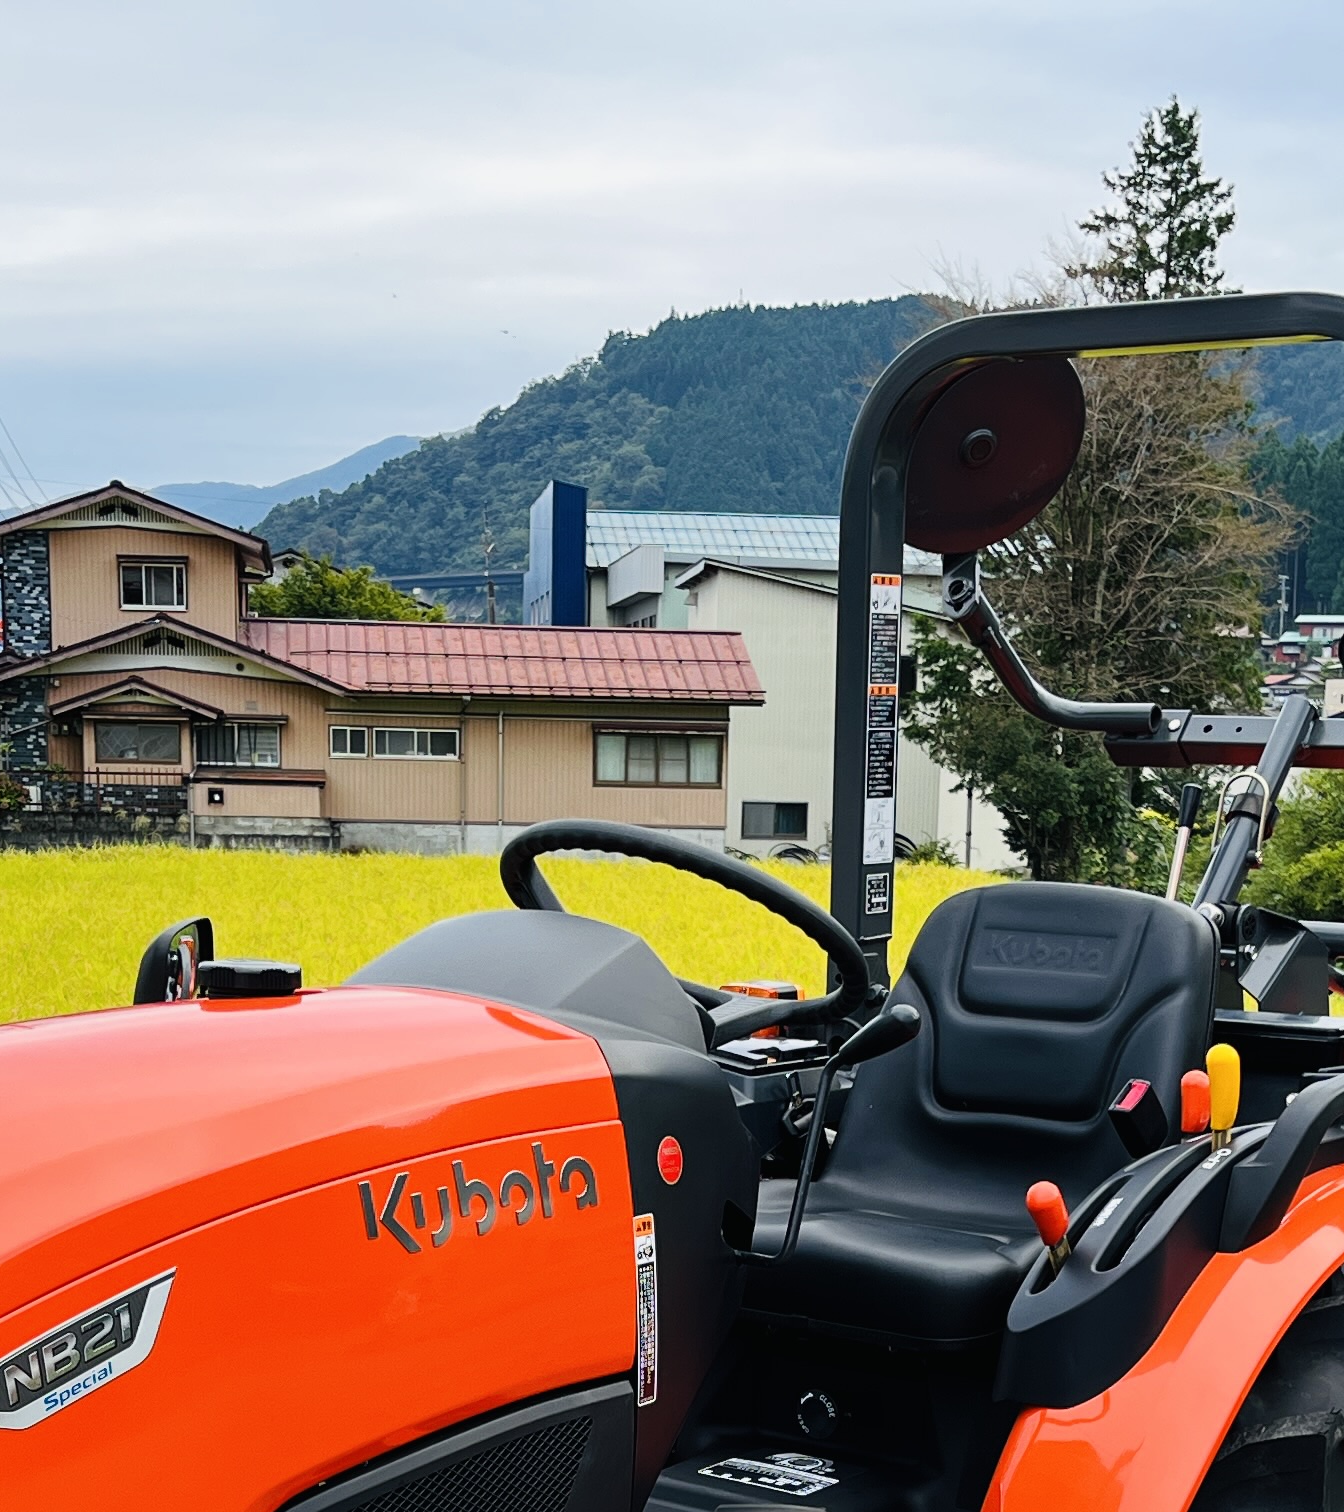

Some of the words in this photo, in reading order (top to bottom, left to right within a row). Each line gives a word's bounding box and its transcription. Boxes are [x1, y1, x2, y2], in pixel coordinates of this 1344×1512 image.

[991, 932, 1104, 971] Kubota
[358, 1141, 599, 1254] Kubota
[3, 1302, 133, 1406] NB21
[43, 1361, 113, 1412] Special
